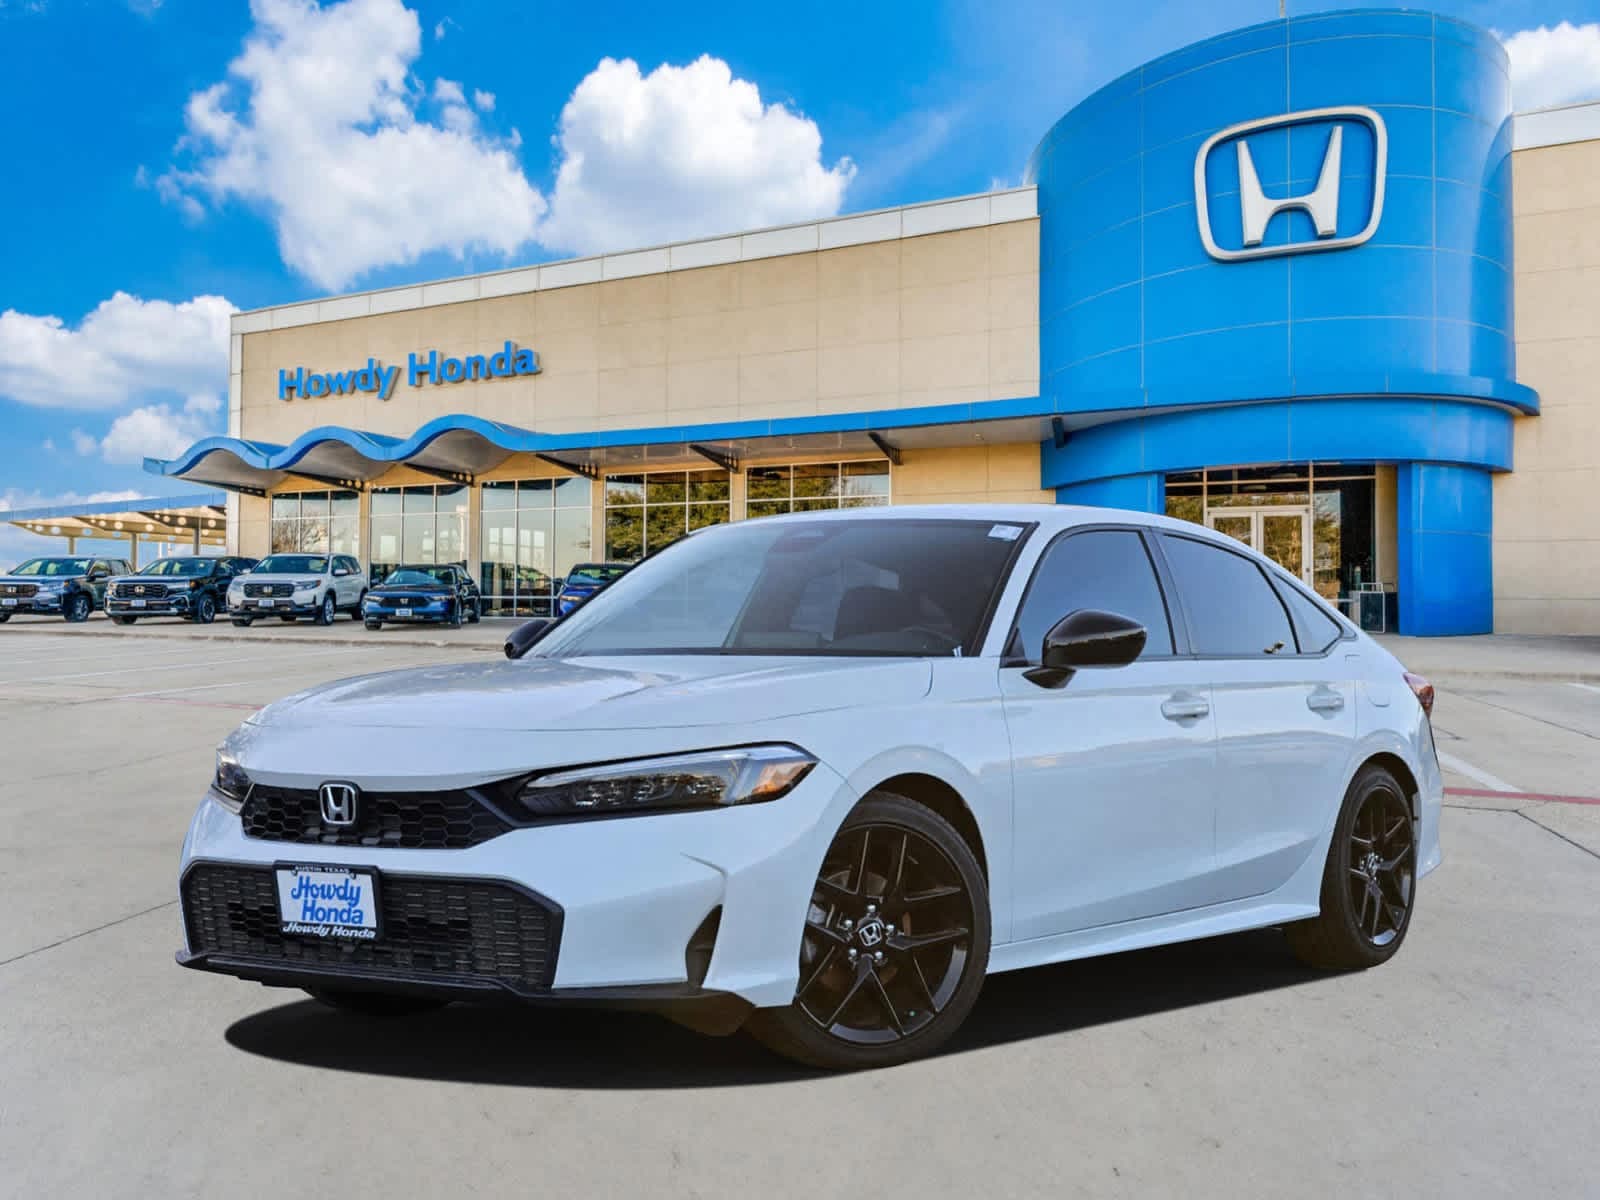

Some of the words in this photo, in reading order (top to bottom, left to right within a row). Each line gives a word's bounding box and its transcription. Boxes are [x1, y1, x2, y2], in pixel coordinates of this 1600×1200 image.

[278, 357, 399, 400] Howdy
[407, 340, 540, 387] Honda
[291, 875, 361, 908] Howdy
[301, 899, 364, 925] Honda
[282, 922, 330, 937] Howdy
[331, 926, 376, 939] Honda
